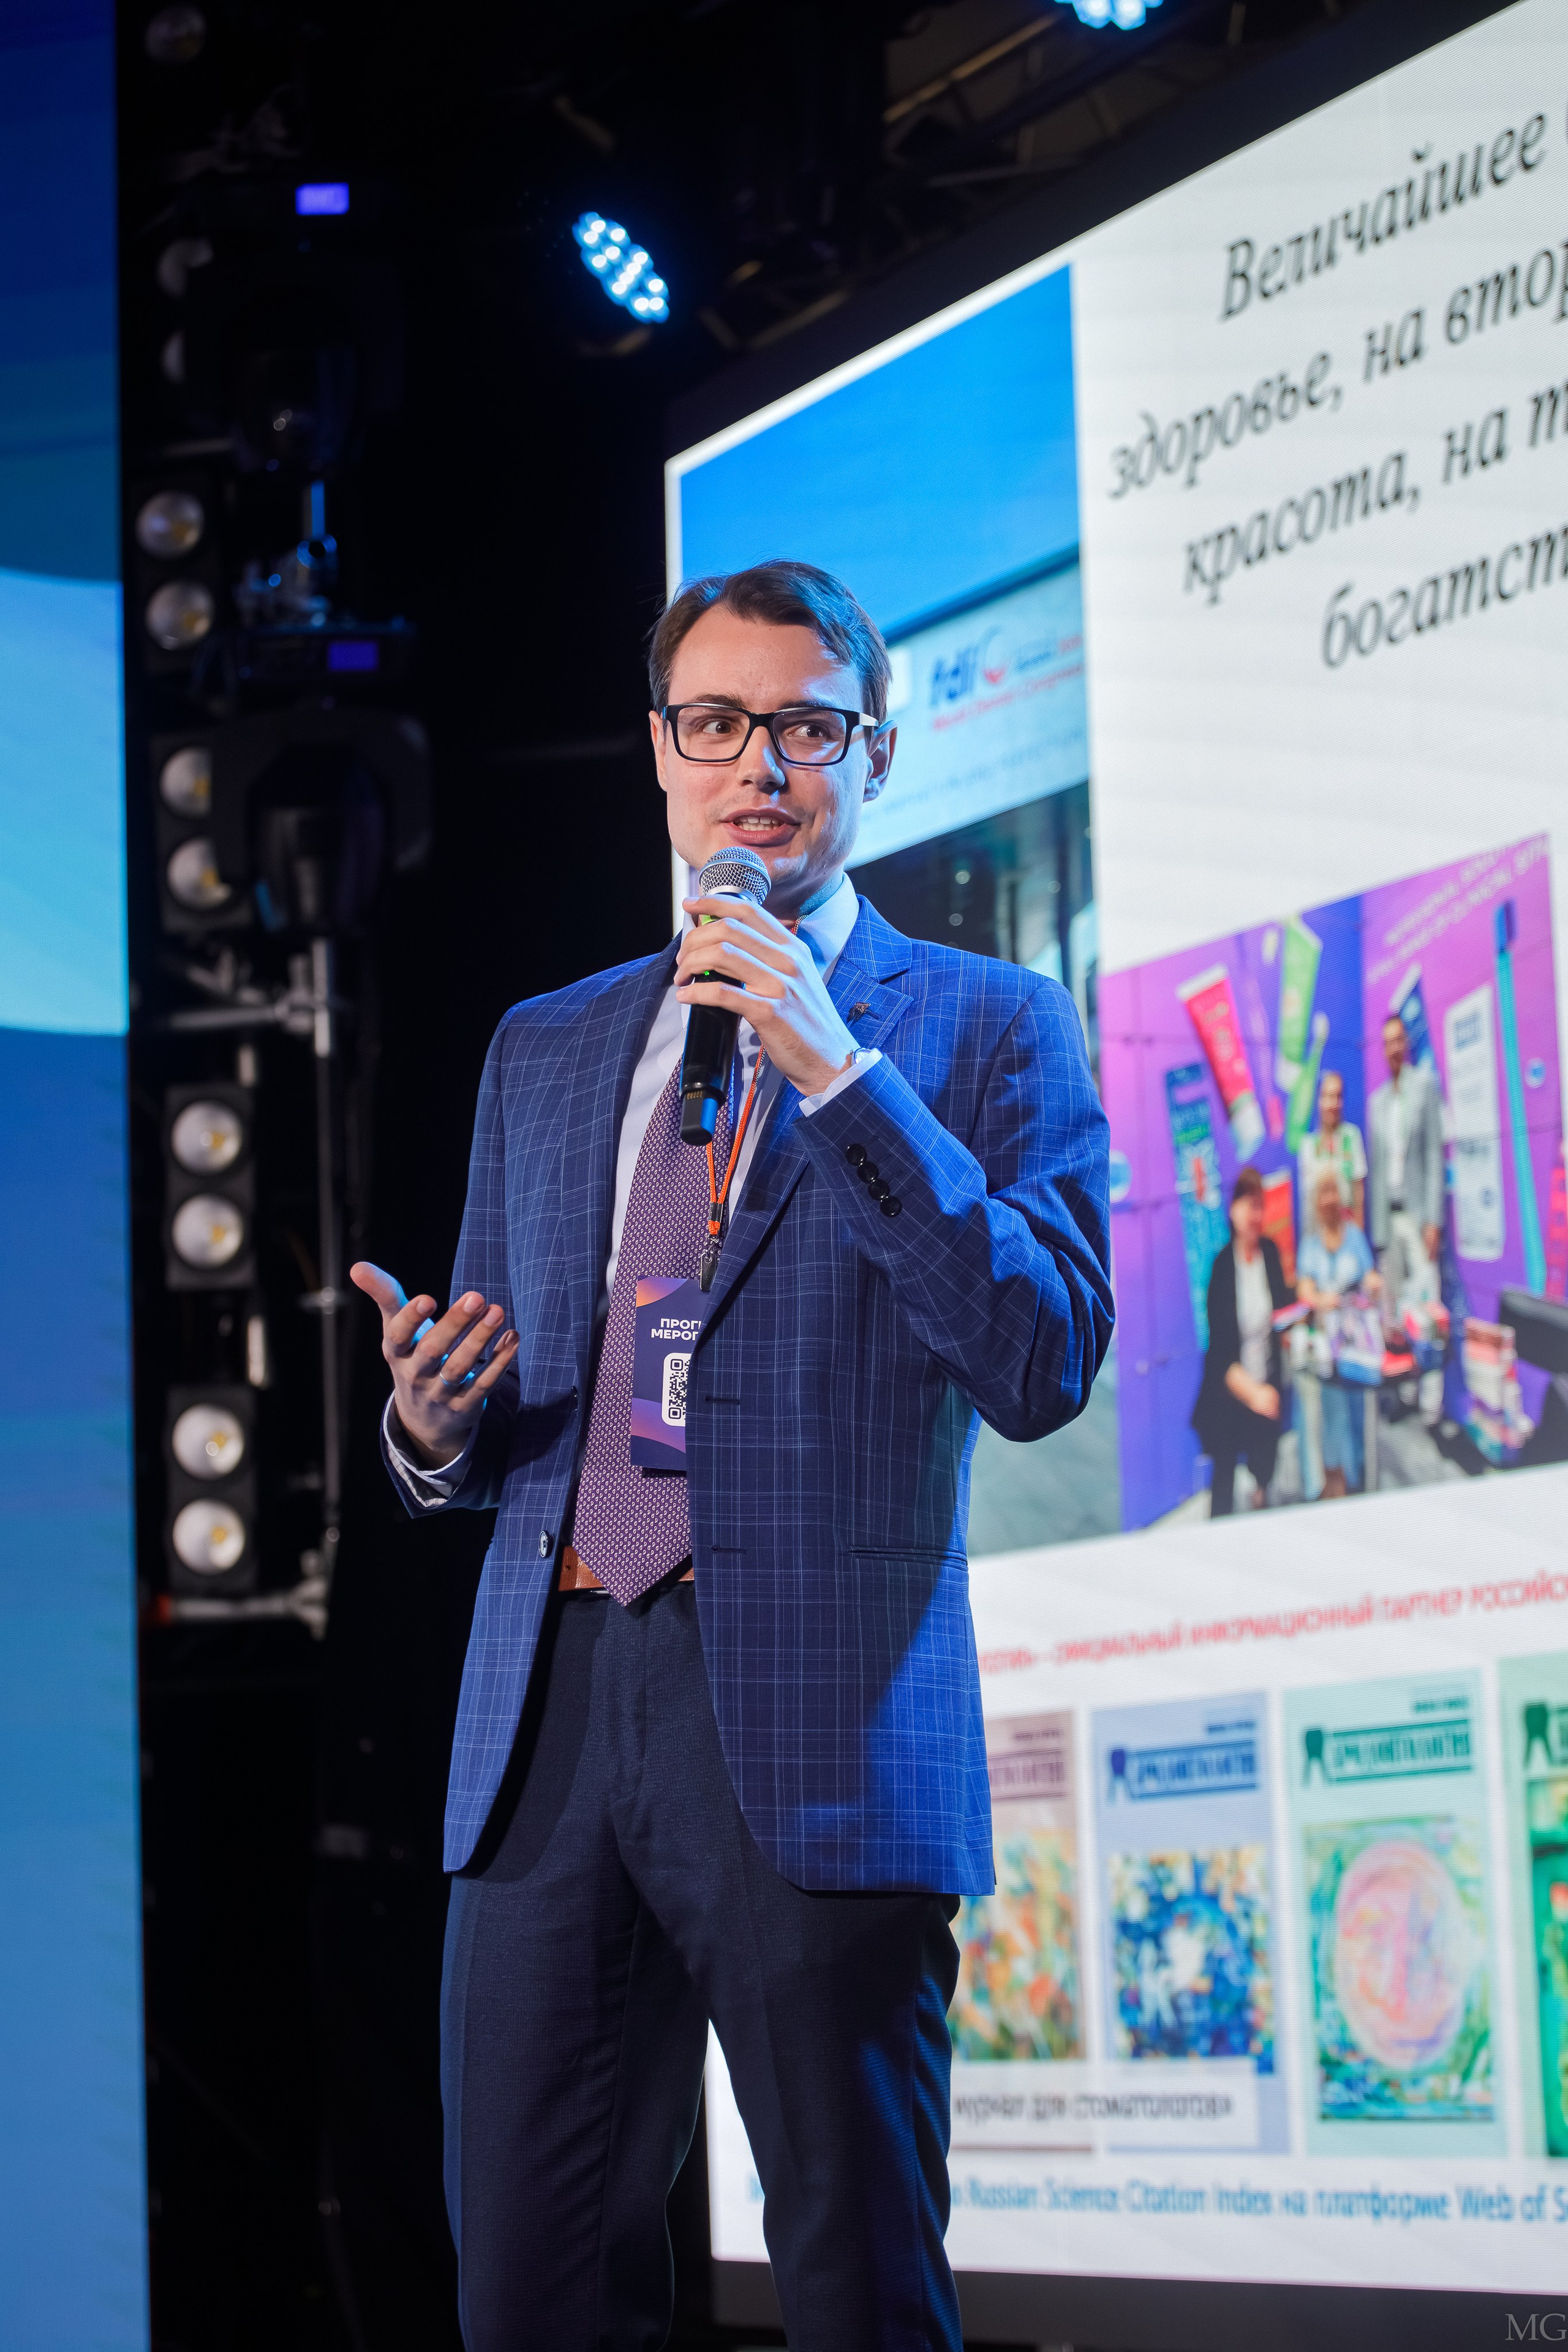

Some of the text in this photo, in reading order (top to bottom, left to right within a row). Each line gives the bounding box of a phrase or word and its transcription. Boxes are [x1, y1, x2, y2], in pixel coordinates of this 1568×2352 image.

[1220, 110, 1547, 323] Величайшее
[1107, 350, 1343, 499] здоровье,
[1362, 309, 1426, 383] на
[1182, 450, 1420, 606] красота,
[1441, 405, 1509, 483] на
